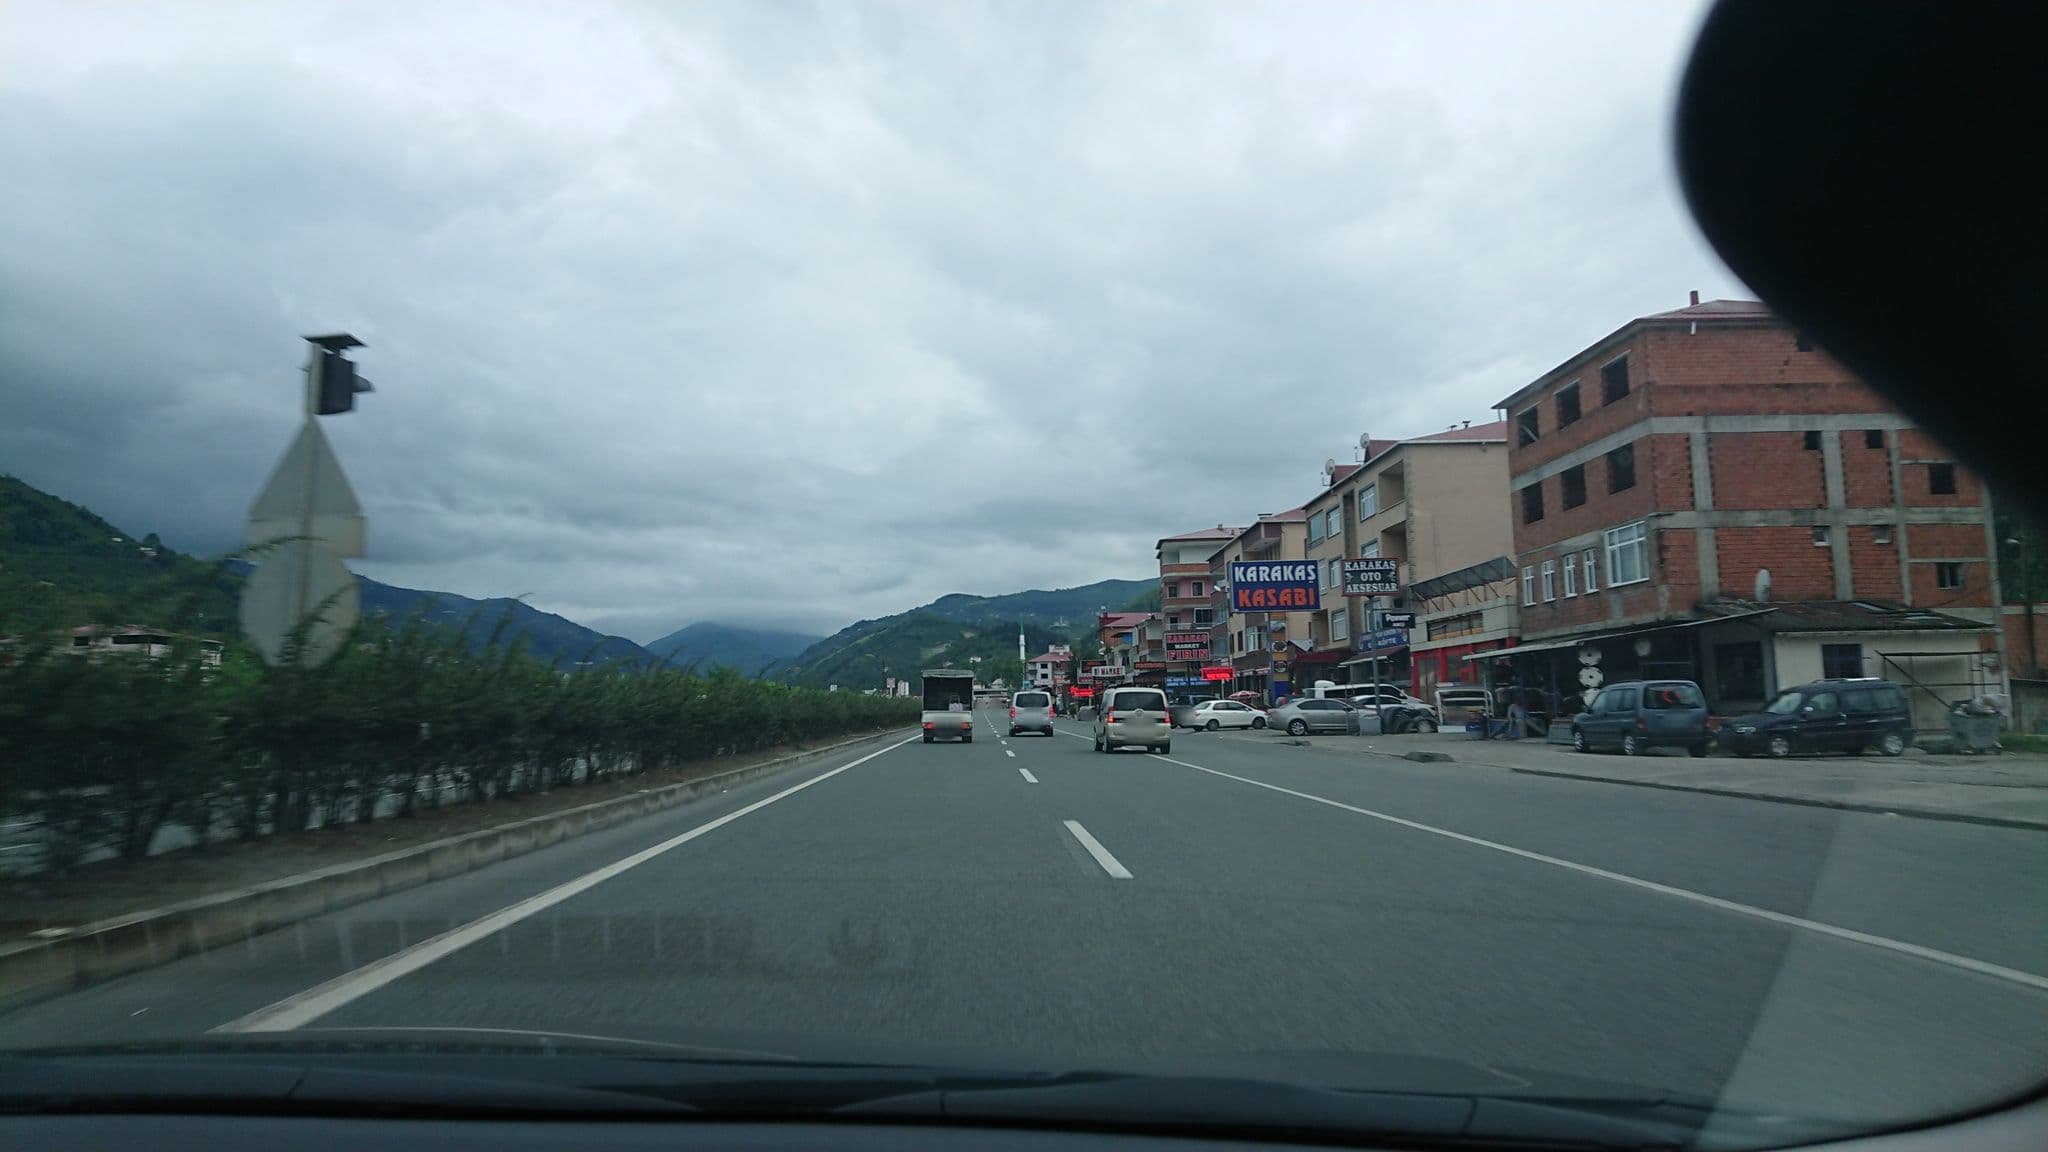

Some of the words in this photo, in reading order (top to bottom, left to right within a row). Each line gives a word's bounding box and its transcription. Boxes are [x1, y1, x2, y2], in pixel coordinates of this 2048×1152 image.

[1235, 565, 1316, 583] KARAKAŞ
[1360, 572, 1381, 581] OTO
[1346, 583, 1398, 592] AKSESUAR
[1238, 588, 1315, 607] KASABI
[1167, 649, 1208, 660] FIRIN
